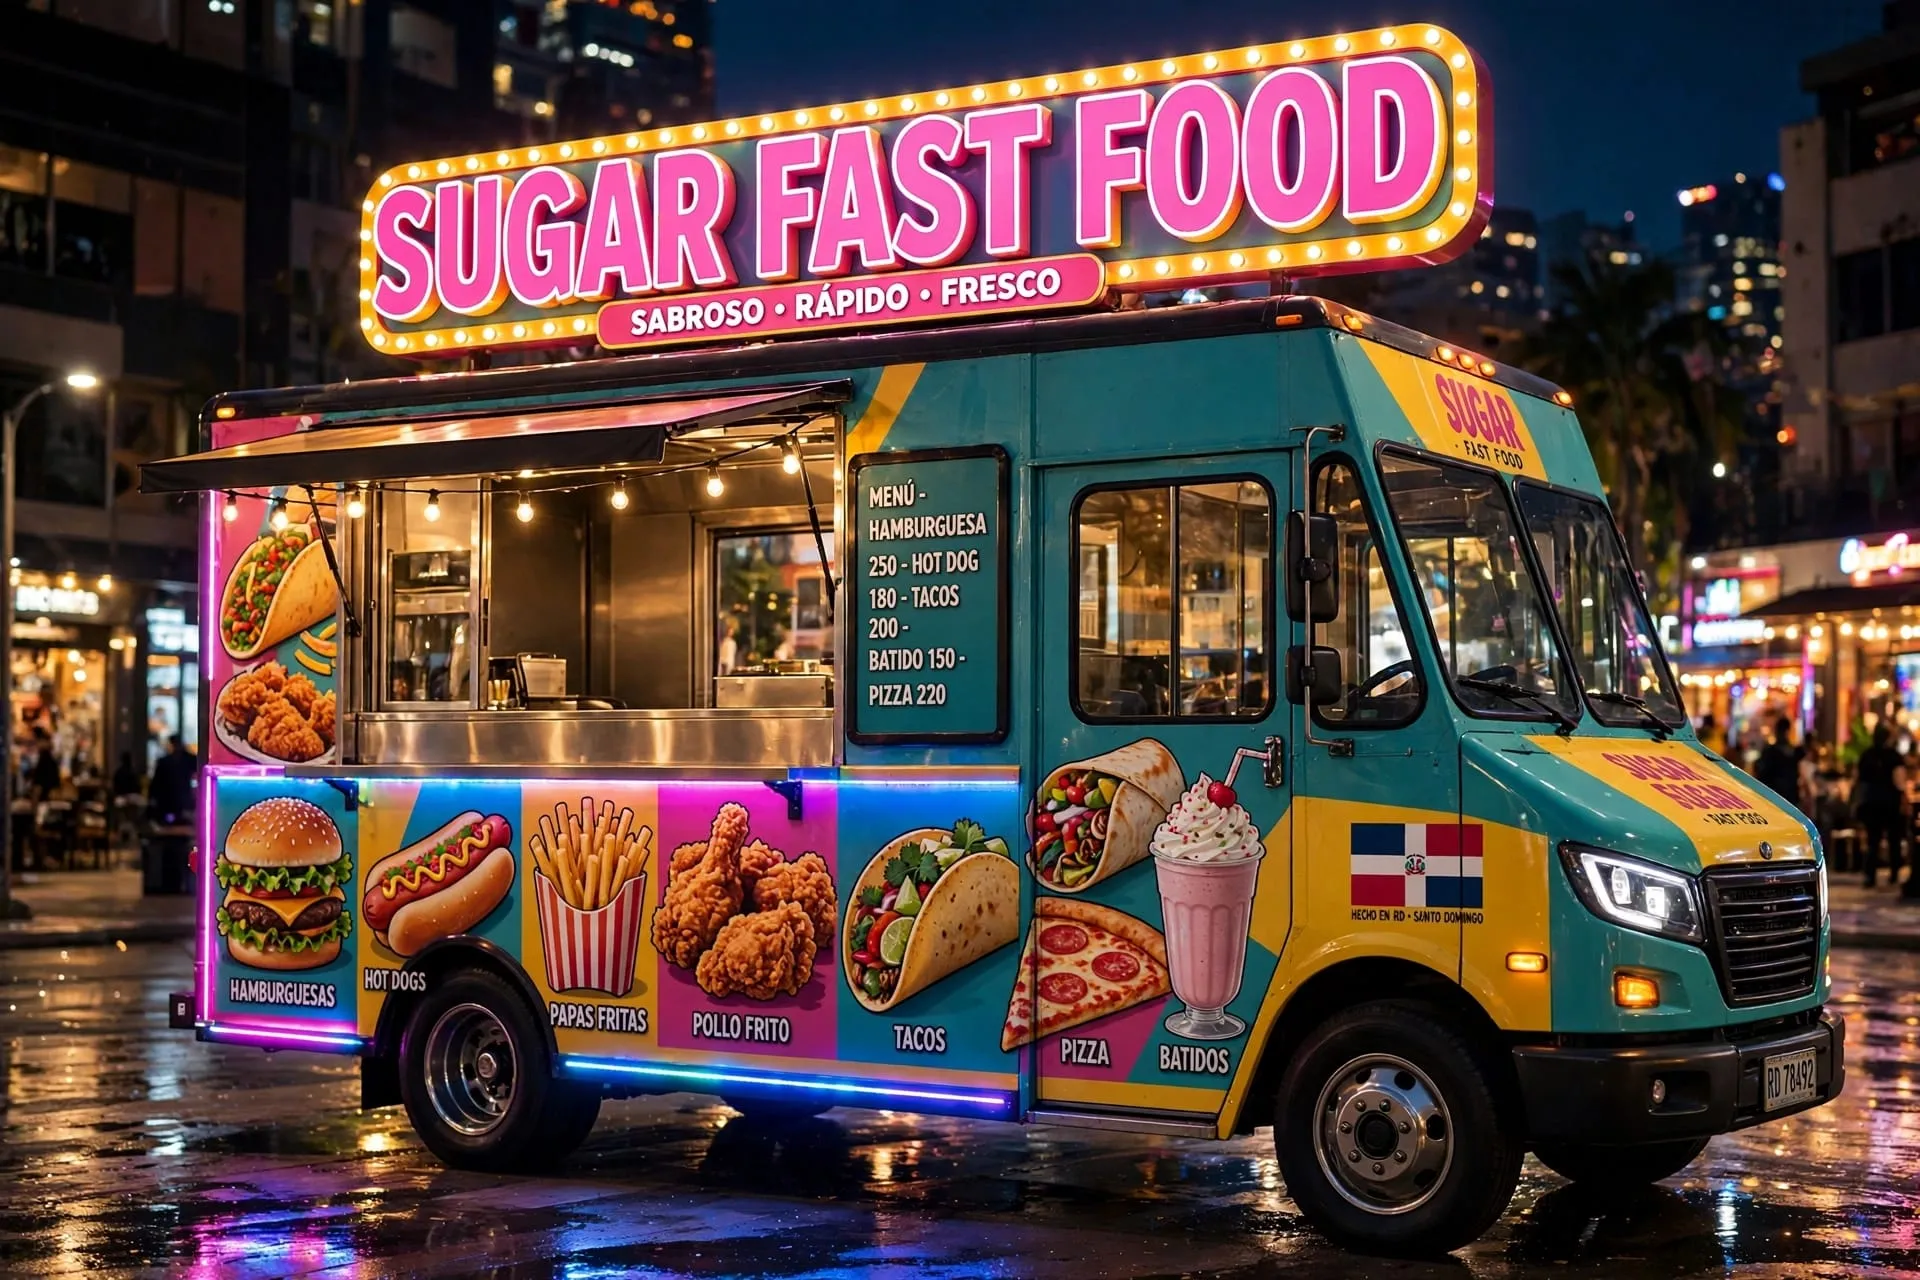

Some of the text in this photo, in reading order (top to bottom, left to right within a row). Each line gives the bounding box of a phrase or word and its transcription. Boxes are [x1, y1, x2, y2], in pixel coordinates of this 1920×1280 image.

[374, 56, 1445, 322] SUGAR FAST FOOD
[631, 268, 1061, 336] SABROSO RÁPIDO FRESCO
[1435, 373, 1525, 451] SUGAR
[1464, 440, 1523, 469] FAST FOOD
[869, 479, 915, 508] MENÚ
[869, 513, 987, 541] HAMBURGUESA
[869, 555, 897, 577] 250
[912, 552, 942, 575] HOT
[947, 550, 979, 573] DOG
[869, 588, 896, 609] 180
[911, 585, 959, 608] TACOS
[869, 617, 898, 639] 200
[869, 649, 923, 671] BATIDO
[928, 648, 955, 669] 150
[869, 684, 946, 706] PIZZA 220
[1351, 909, 1484, 924] HECHO EN RD SANTO DOMINGO
[230, 979, 335, 1008] HAMBURGUESAS
[365, 969, 426, 992] HOT DOGS
[550, 1003, 648, 1033] PAPAS FRITAS
[693, 1012, 790, 1043] POLLO FRITO
[894, 1025, 946, 1053] TACOS
[1061, 1038, 1109, 1066] PIZZA
[1159, 1044, 1229, 1074] BATIDOS
[1768, 1060, 1813, 1099] RD 78492
